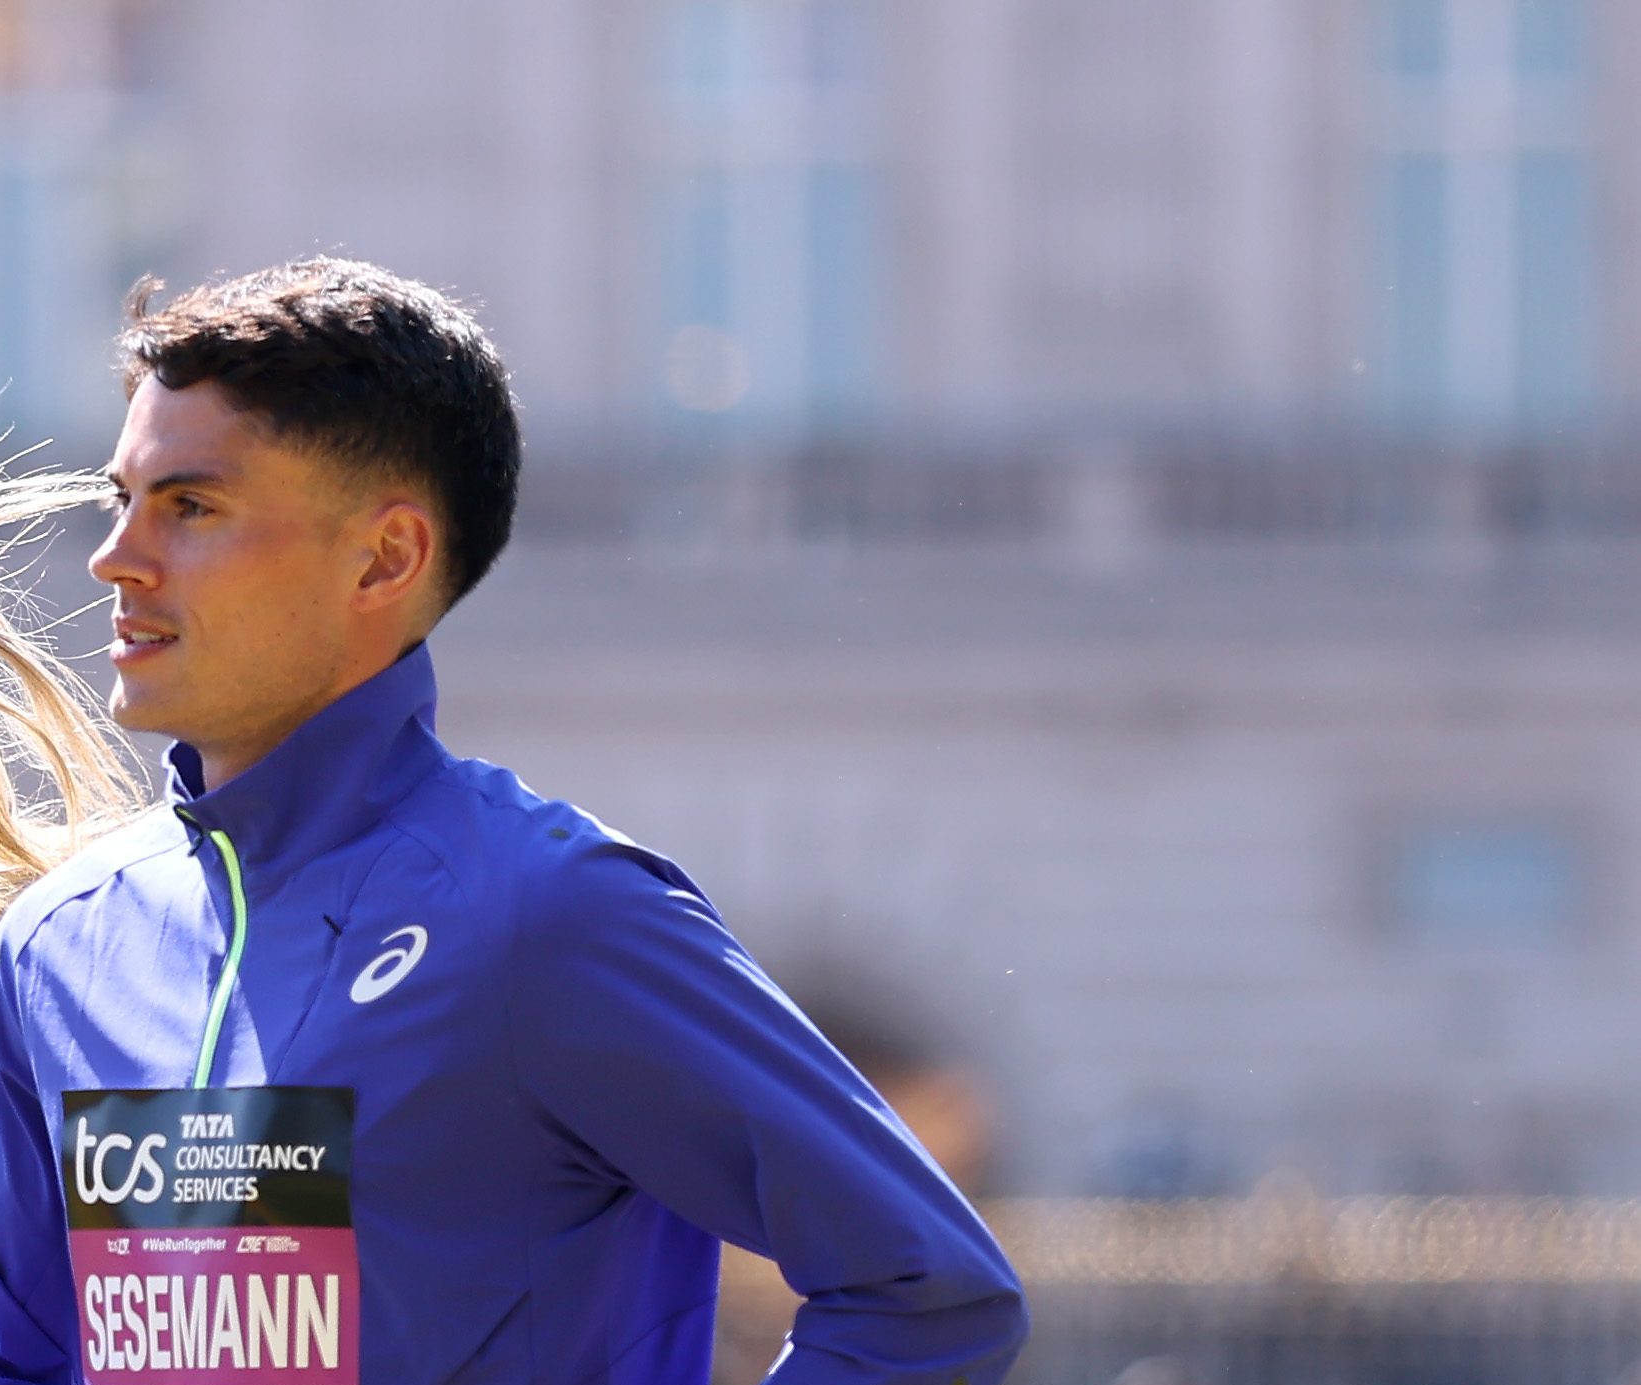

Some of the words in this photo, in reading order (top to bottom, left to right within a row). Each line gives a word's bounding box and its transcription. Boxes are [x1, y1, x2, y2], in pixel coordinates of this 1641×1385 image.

[181, 1113, 235, 1139] TATA
[75, 1115, 168, 1205] tcs
[175, 1144, 327, 1172] CONSULTANCY
[172, 1176, 259, 1203] SERVICES
[142, 1237, 227, 1255] #WeRunTogether
[84, 1273, 340, 1373] SESEMANN
